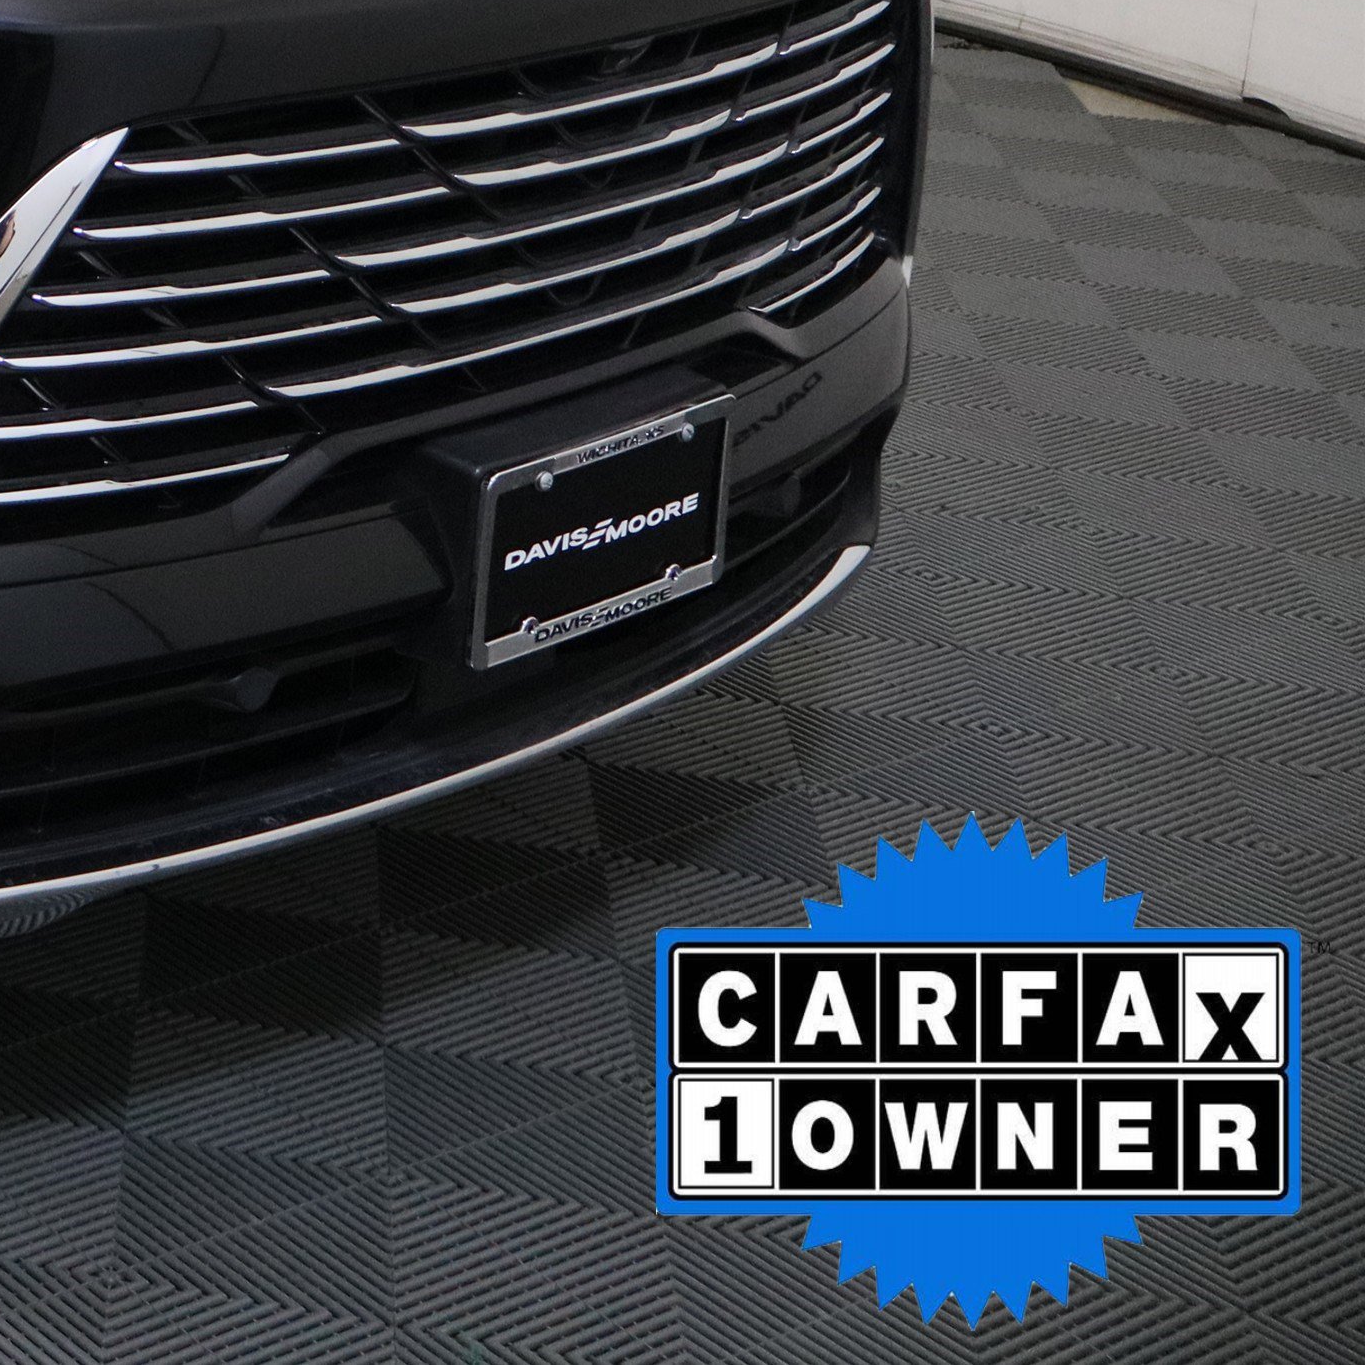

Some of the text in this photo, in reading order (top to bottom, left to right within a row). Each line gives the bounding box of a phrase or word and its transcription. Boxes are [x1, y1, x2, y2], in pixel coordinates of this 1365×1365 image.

[504, 492, 700, 571] DAVIS MOORE
[534, 587, 673, 643] DAVIS MOORE
